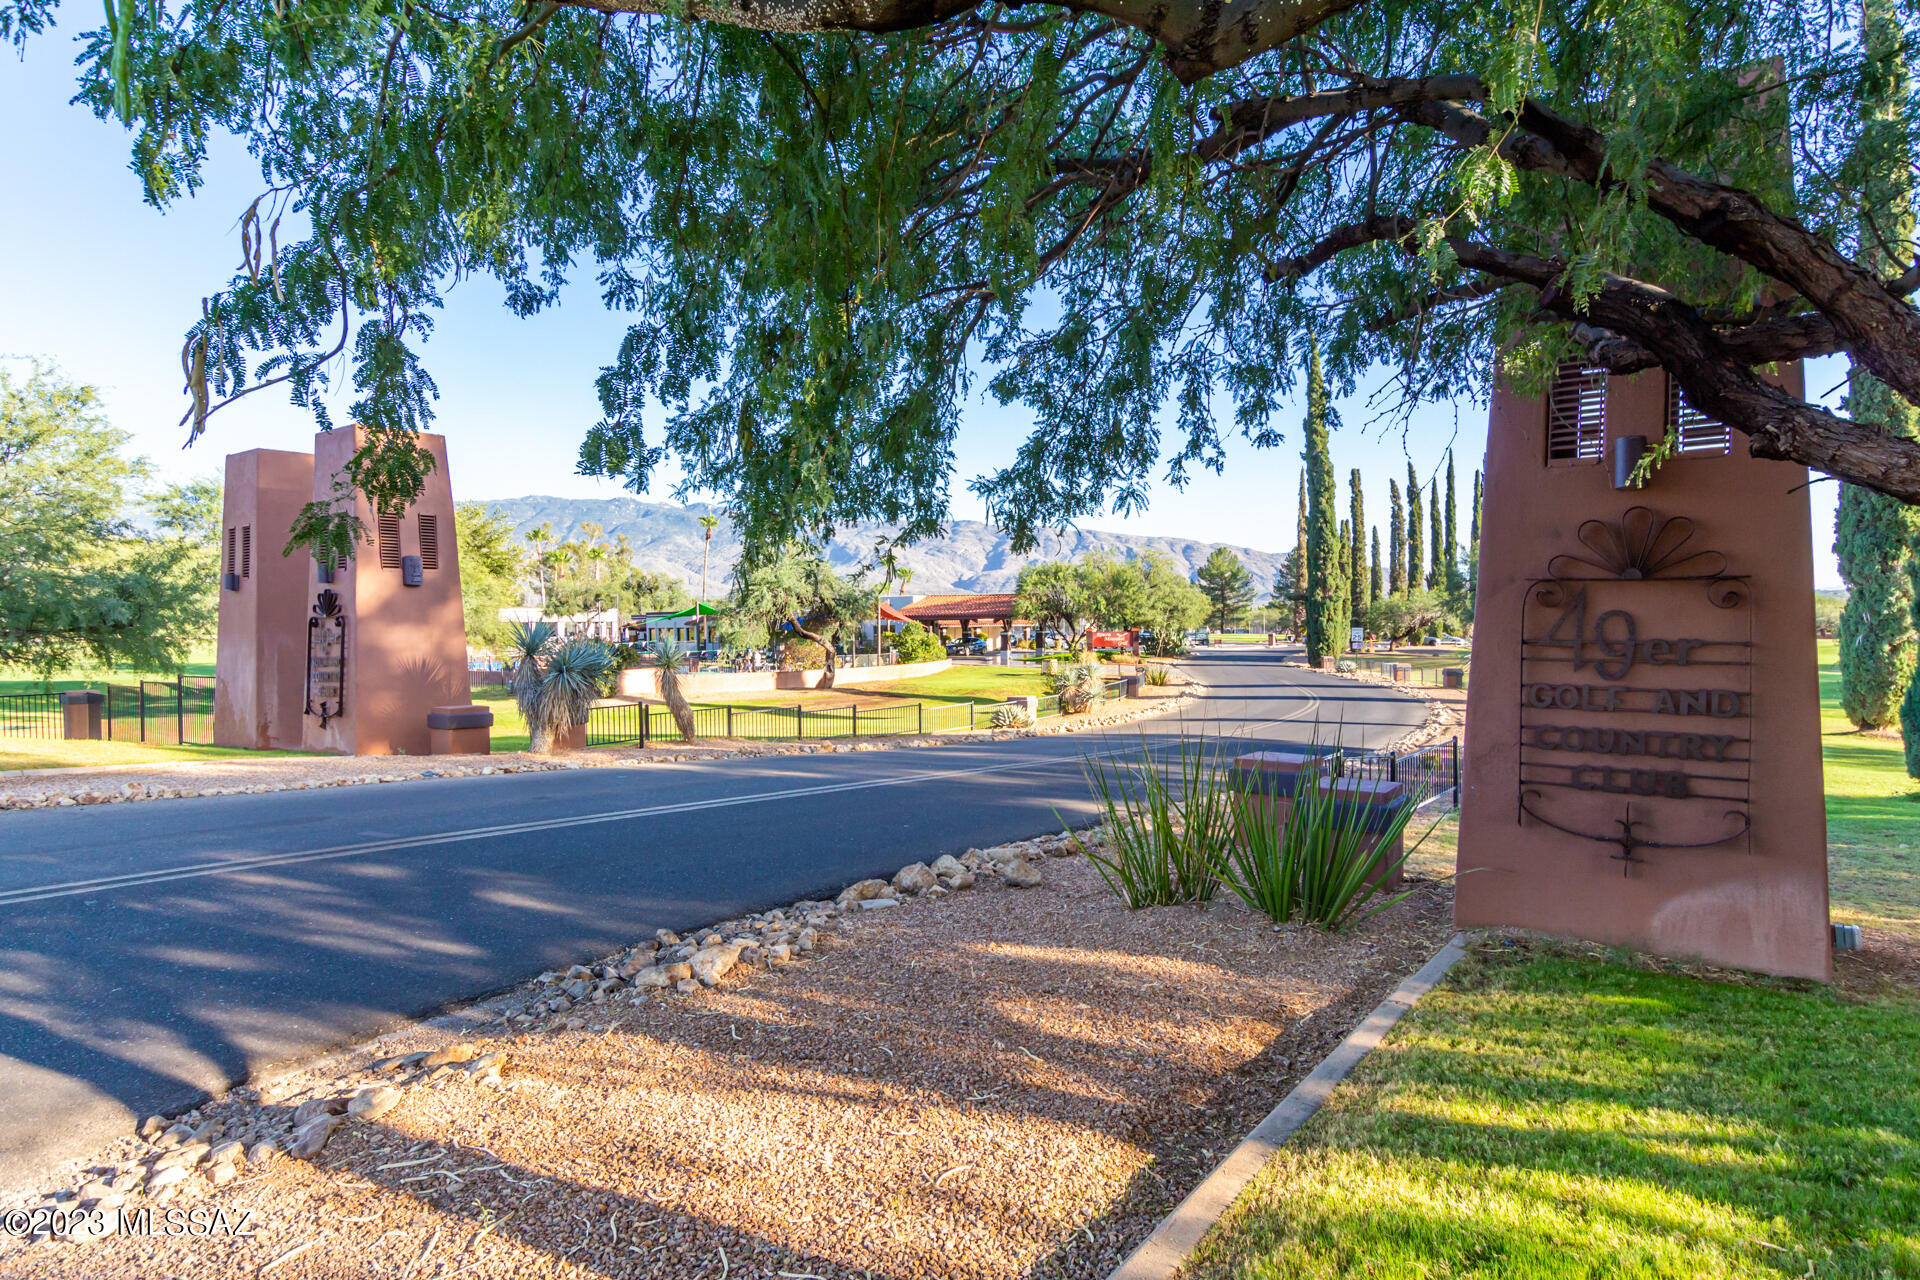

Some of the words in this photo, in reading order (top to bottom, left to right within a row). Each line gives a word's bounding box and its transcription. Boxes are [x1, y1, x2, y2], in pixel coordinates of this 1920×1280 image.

[1535, 584, 1703, 681] 49er
[1528, 683, 1628, 712] GOLF
[1652, 688, 1740, 718] AND
[1535, 724, 1735, 762] COUNTRY
[1571, 764, 1688, 799] CLUB
